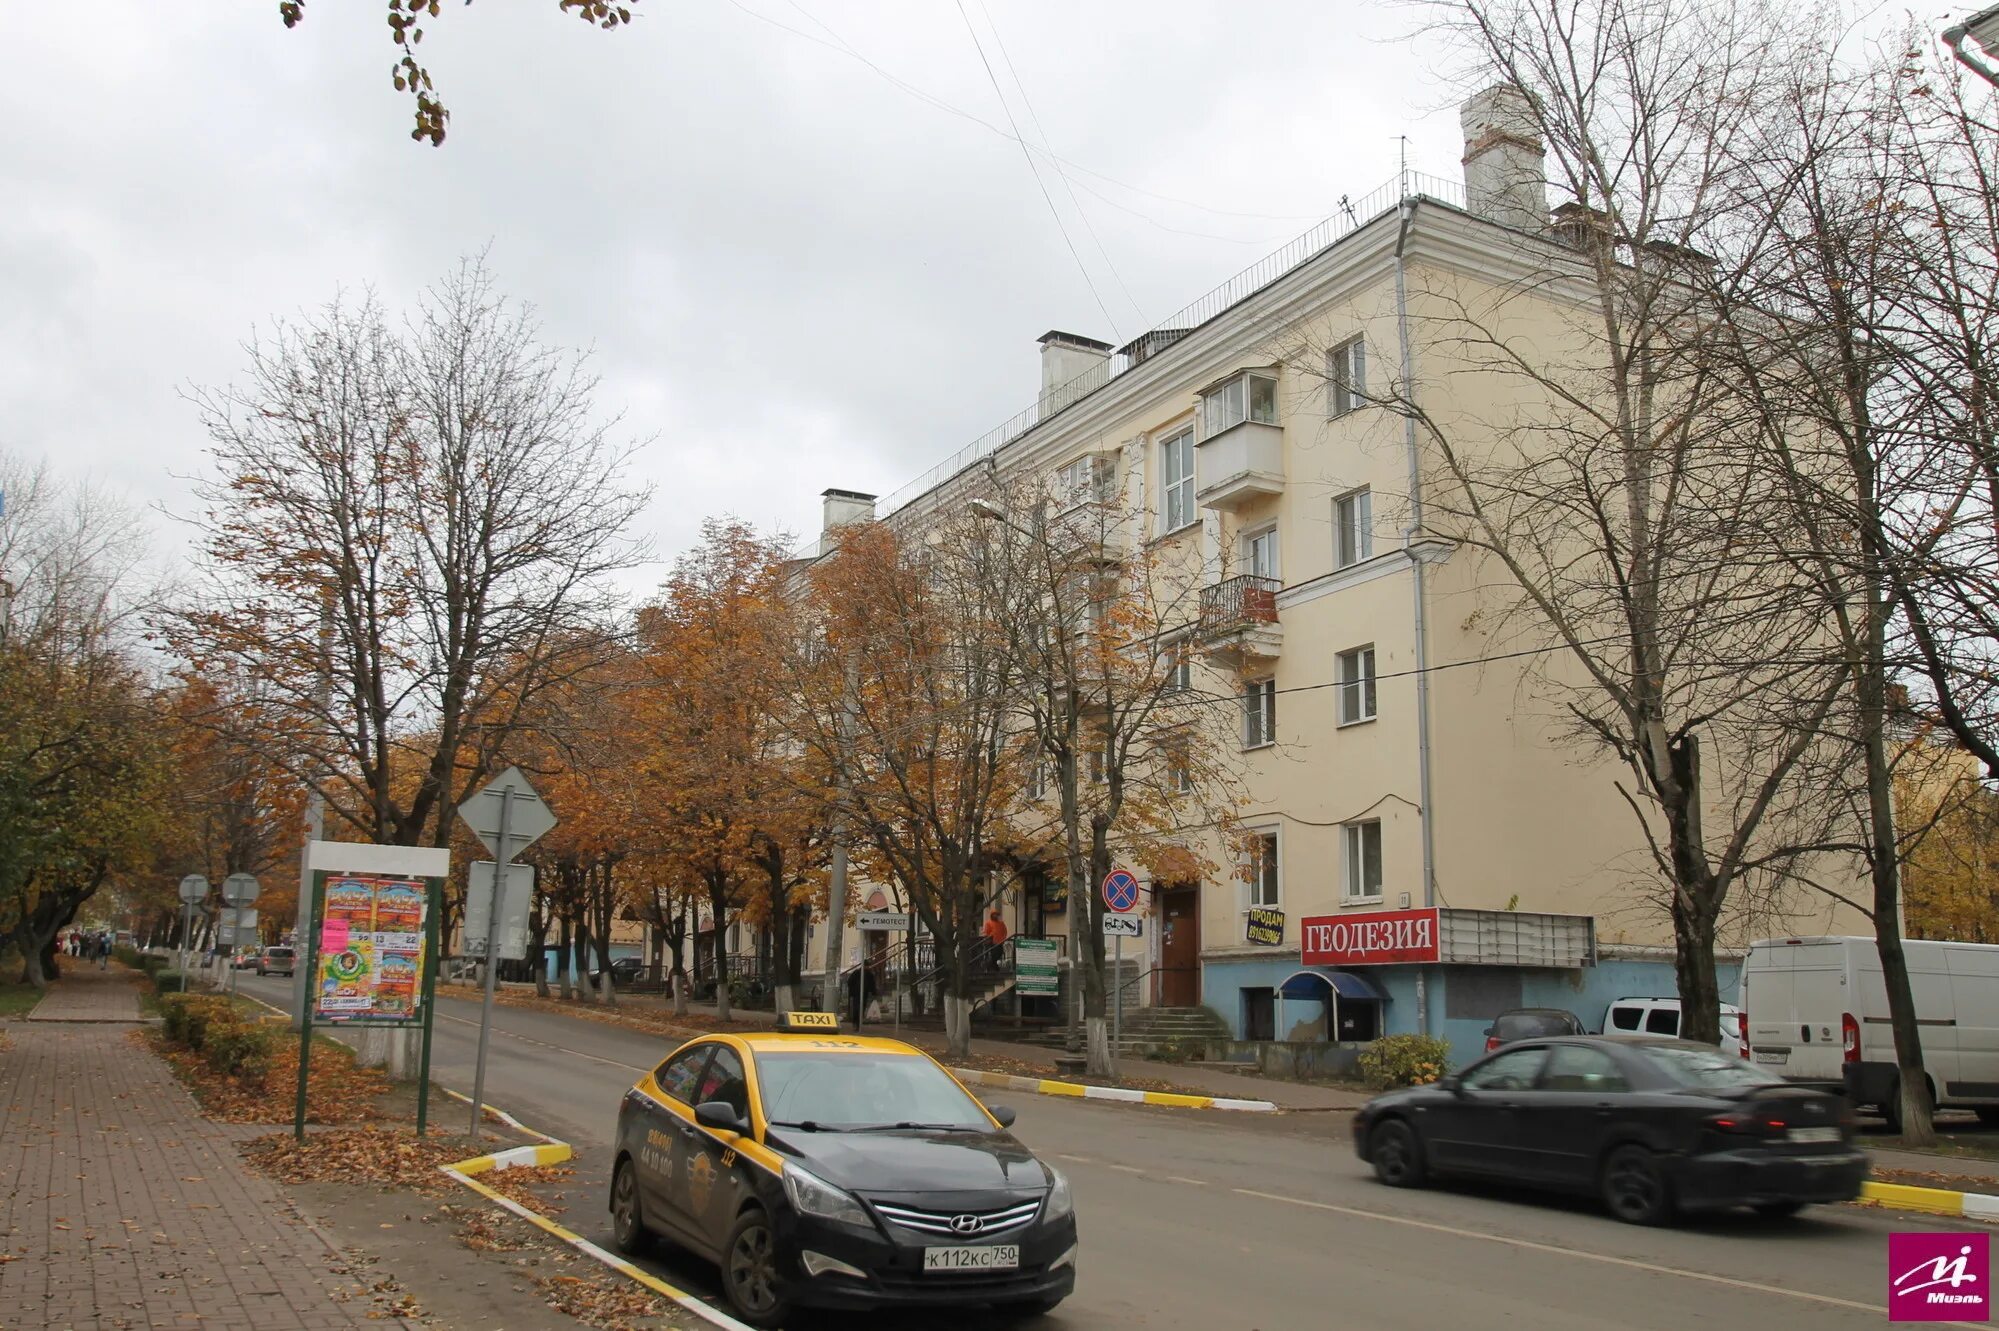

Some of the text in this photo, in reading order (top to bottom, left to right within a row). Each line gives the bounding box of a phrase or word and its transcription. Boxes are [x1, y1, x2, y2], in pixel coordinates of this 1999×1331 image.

[1251, 909, 1284, 927] ПРОДАМ
[406, 936, 417, 944] 22
[1306, 918, 1433, 958] ГЕОДЕЗИЯ
[792, 1014, 831, 1025] TAXI
[809, 1040, 865, 1049] 112
[720, 1147, 737, 1169] 112
[993, 1246, 1016, 1260] 750
